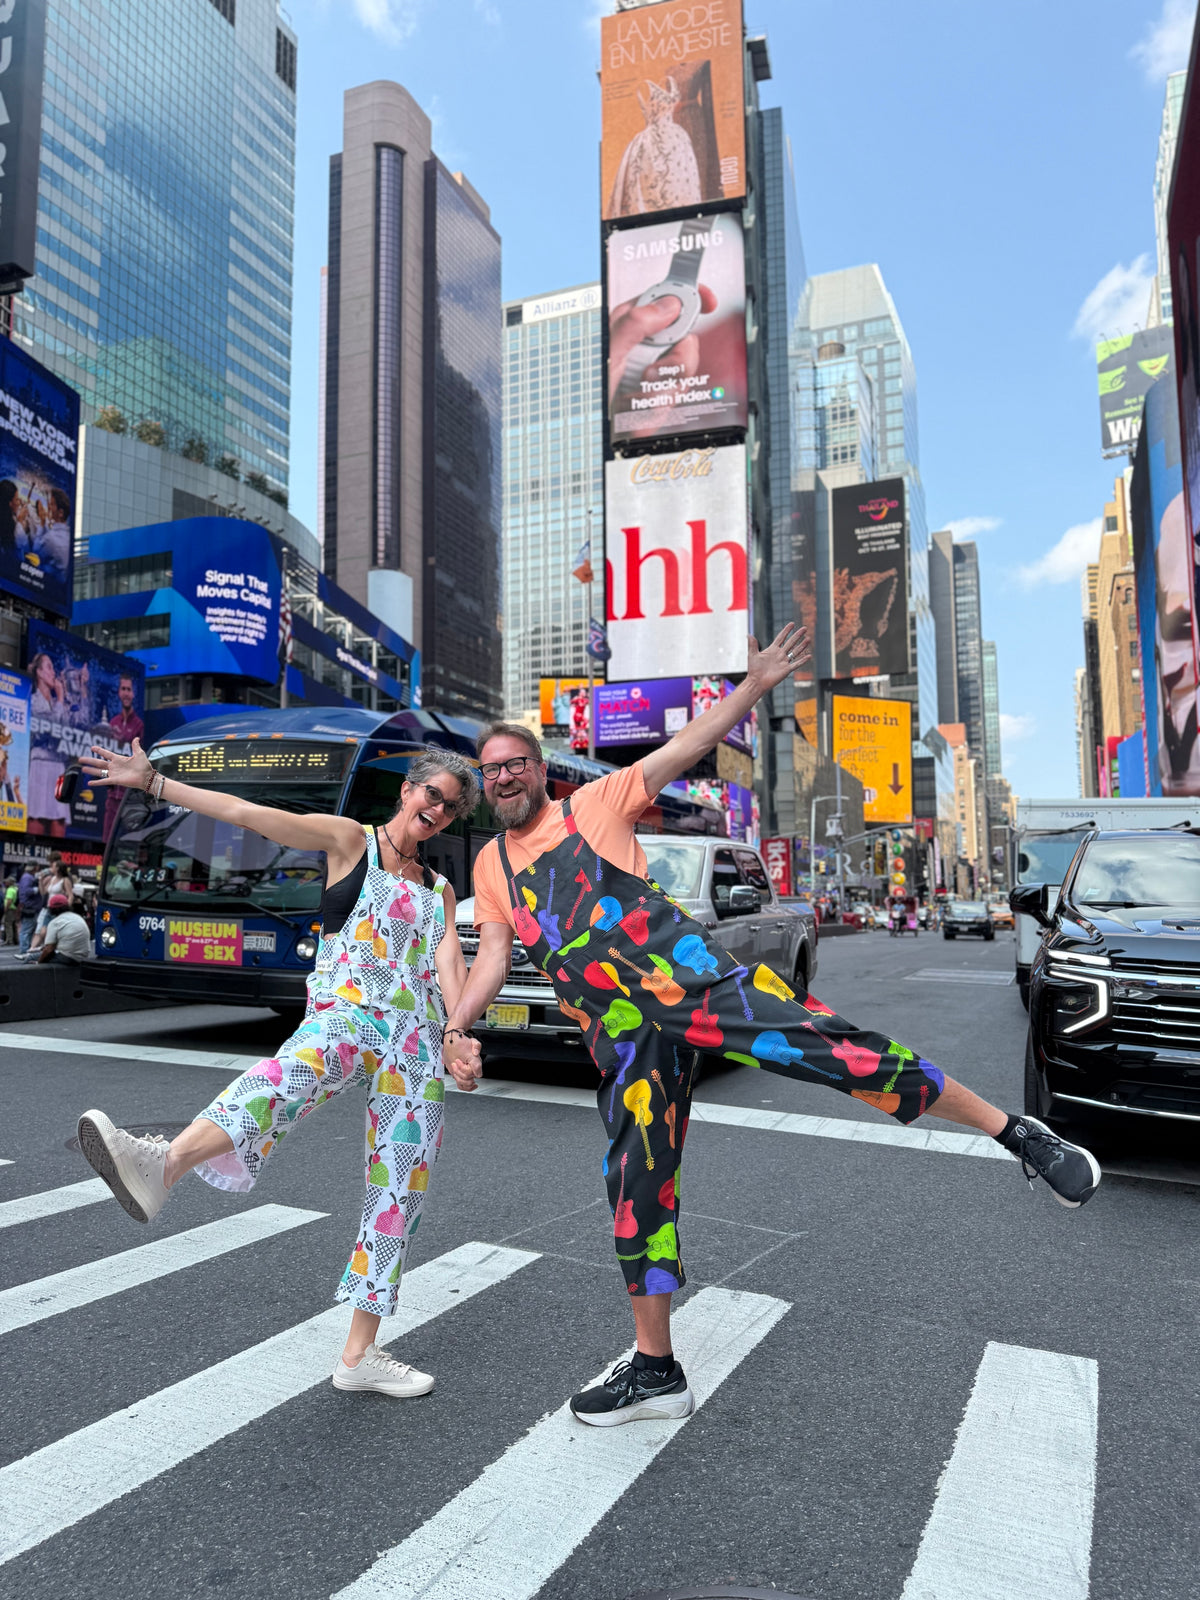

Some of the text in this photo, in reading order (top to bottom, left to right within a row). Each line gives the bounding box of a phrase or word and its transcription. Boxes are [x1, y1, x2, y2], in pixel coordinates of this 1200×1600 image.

[617, 1, 724, 43] LA MODE
[608, 42, 636, 69] EN
[623, 229, 724, 262] SAMSUNG
[533, 298, 577, 317] Allianz
[658, 365, 680, 376] Step
[640, 374, 710, 393] Track your
[631, 389, 712, 410] health index
[0, 389, 76, 454] NEW YORK
[9, 410, 66, 458] KNOWS
[606, 519, 747, 621] hh
[205, 569, 268, 594] Signal That
[196, 585, 272, 610] Moves Capital
[599, 697, 650, 714] MATCH
[9, 708, 24, 726] BEE
[838, 711, 900, 727] come in
[30, 717, 133, 757] SPECTACULA
[839, 723, 855, 742] for
[857, 725, 876, 743] the
[168, 805, 183, 814] Sign
[4, 842, 31, 856] BLUE
[767, 841, 787, 881] tkts
[139, 916, 165, 932] 9764
[169, 921, 237, 939] MUSEUM
[169, 943, 236, 962] OF SEX
